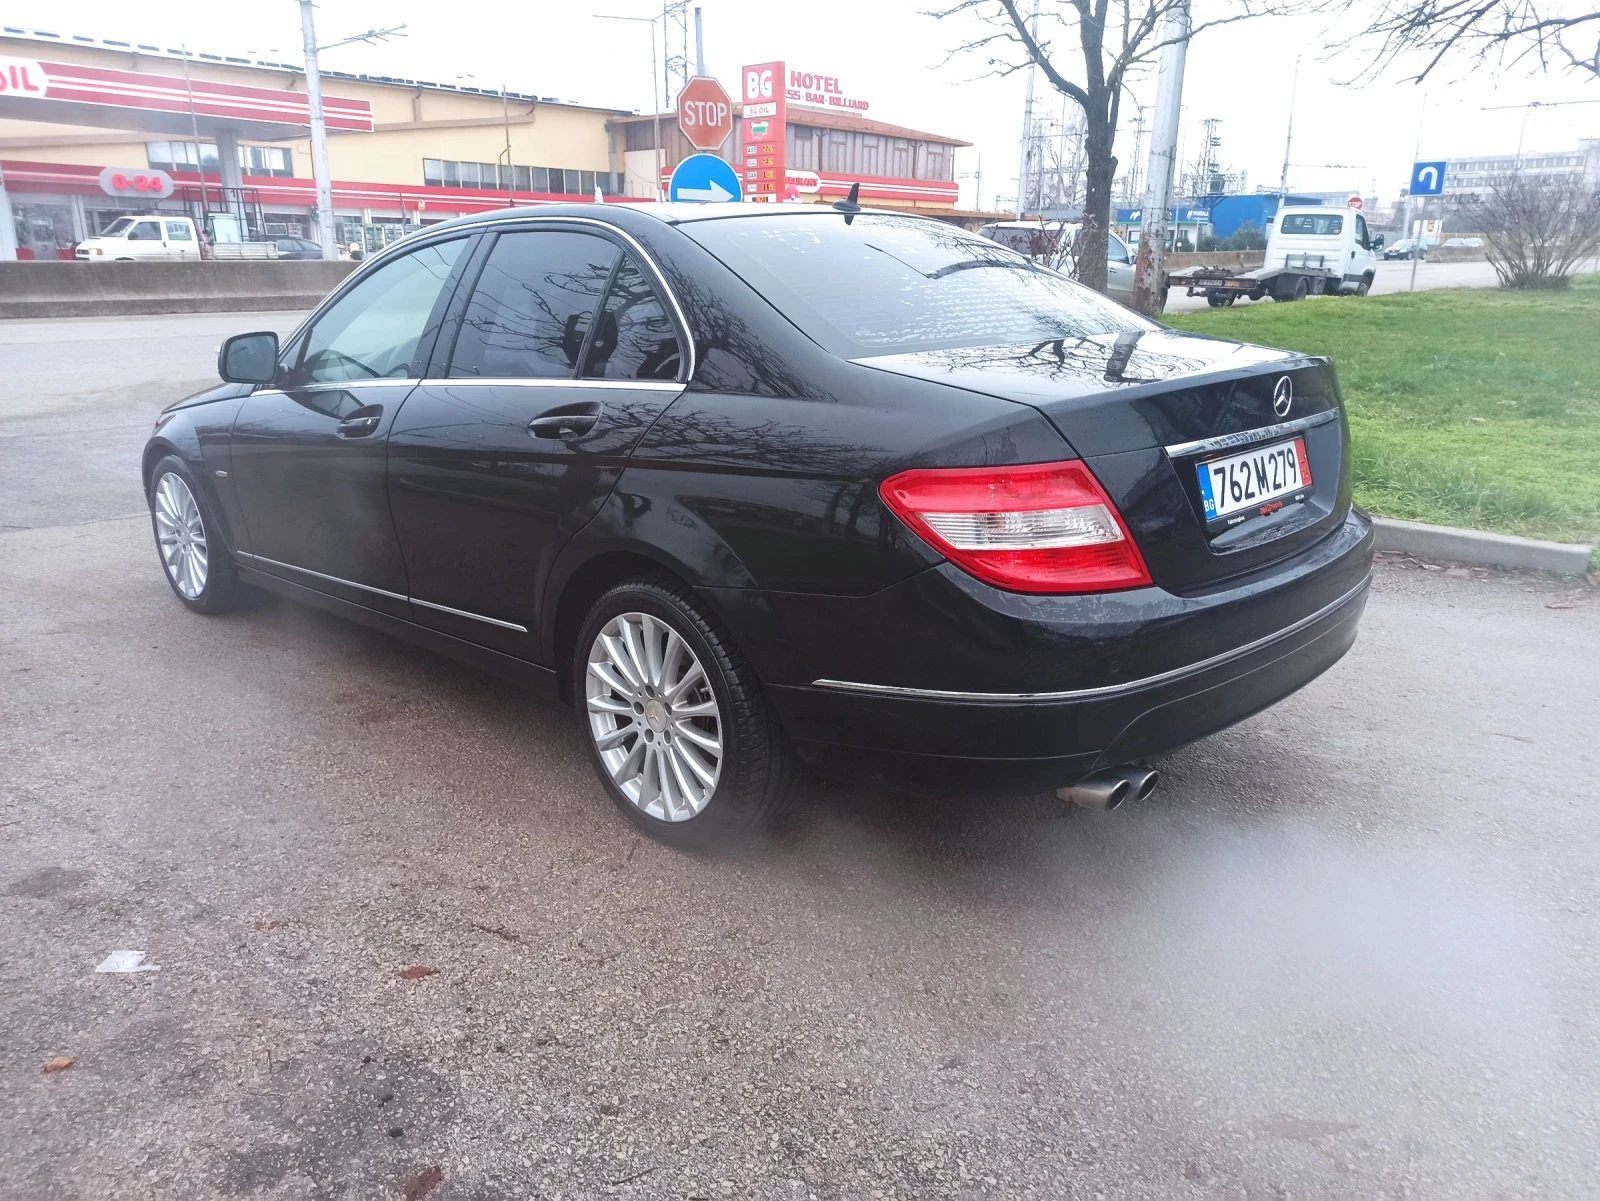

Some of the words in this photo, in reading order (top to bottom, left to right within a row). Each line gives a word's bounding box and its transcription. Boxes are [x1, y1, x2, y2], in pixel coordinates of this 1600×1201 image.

[747, 70, 773, 99] BG
[790, 70, 843, 95] HOTEL
[758, 105, 769, 114] OIL
[805, 91, 825, 105] BAR
[829, 95, 869, 111] BILLIARD
[684, 100, 728, 127] STOP
[112, 173, 163, 193] 0-24
[1213, 447, 1297, 509] 762M279
[1203, 499, 1215, 512] BG
